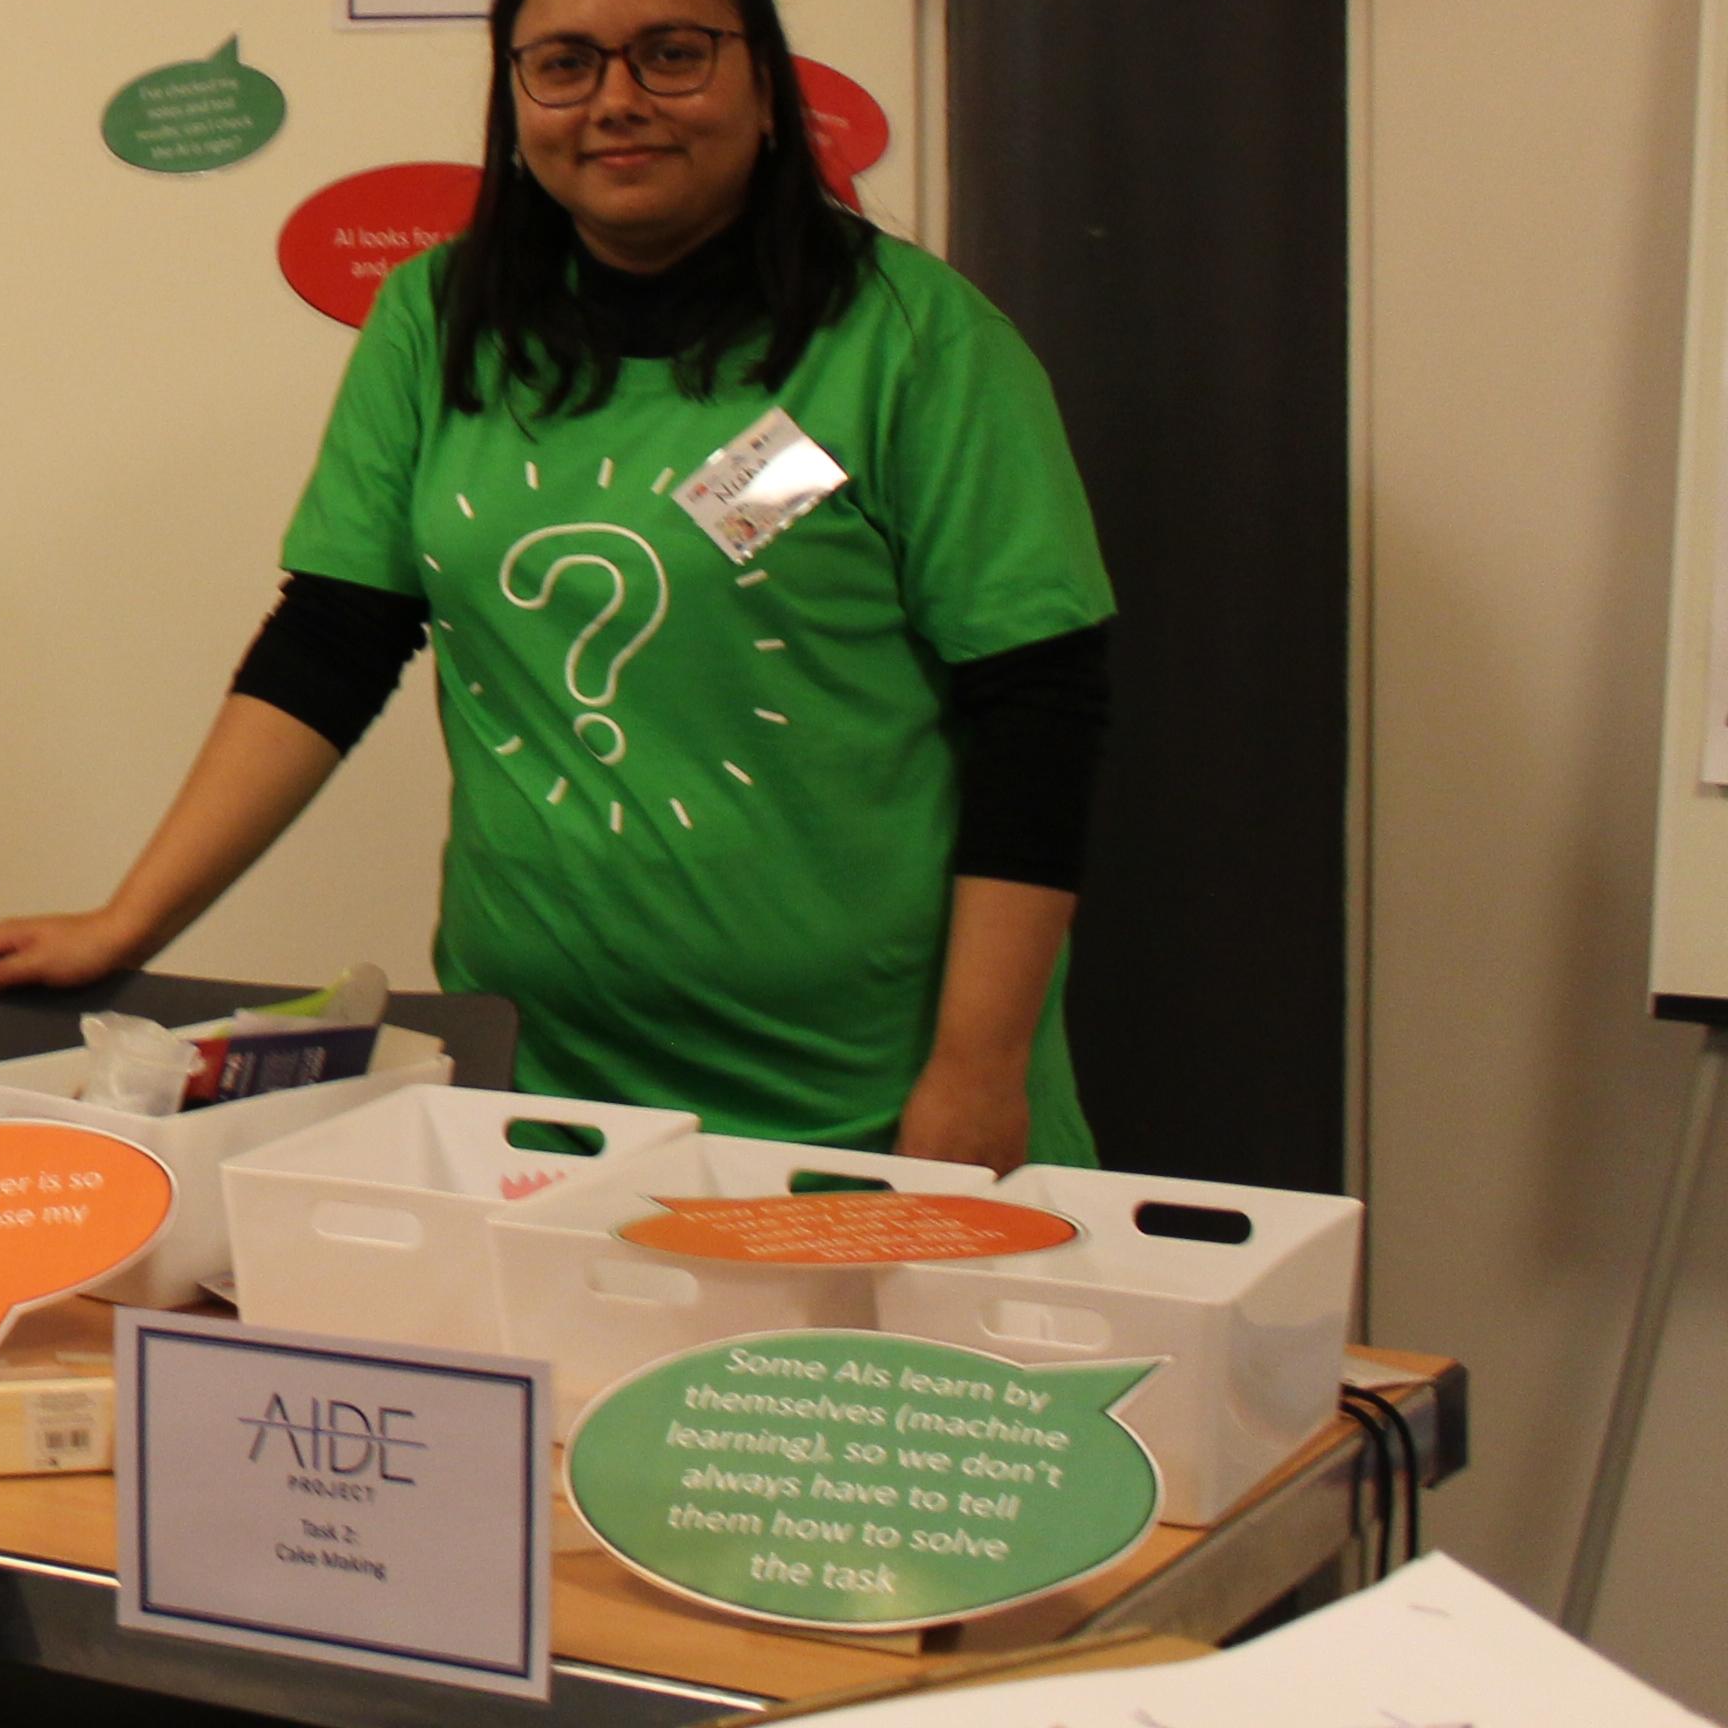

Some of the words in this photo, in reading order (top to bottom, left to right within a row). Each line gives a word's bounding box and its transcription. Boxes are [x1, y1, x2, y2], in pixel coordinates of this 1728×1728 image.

[334, 227, 356, 248] AI
[358, 225, 410, 249] looks
[350, 257, 389, 280] and
[38, 1170, 62, 1193] is
[68, 1171, 104, 1191] so
[42, 1204, 91, 1229] my
[724, 1347, 827, 1383] Some
[834, 1359, 893, 1389] AIs
[899, 1365, 995, 1403] learn
[1003, 1380, 1052, 1415] by
[685, 1383, 887, 1427] themselves
[895, 1402, 1071, 1452] (machine
[236, 1393, 429, 1486] AIDE
[666, 1419, 834, 1464] learning),
[843, 1440, 887, 1466] so
[897, 1447, 954, 1473] we
[961, 1451, 1064, 1489] don't
[287, 1473, 377, 1506] PROJECT
[681, 1463, 802, 1502] always
[810, 1472, 900, 1507] have
[908, 1485, 948, 1513] to
[958, 1490, 1023, 1521] tell
[299, 1518, 340, 1543] Task
[667, 1502, 765, 1536] them
[771, 1509, 856, 1544] how
[861, 1520, 902, 1550] to
[908, 1527, 1012, 1562] solve
[274, 1542, 319, 1568] Cake
[320, 1549, 388, 1583] Making
[750, 1551, 814, 1587] the
[822, 1560, 898, 1594] task
